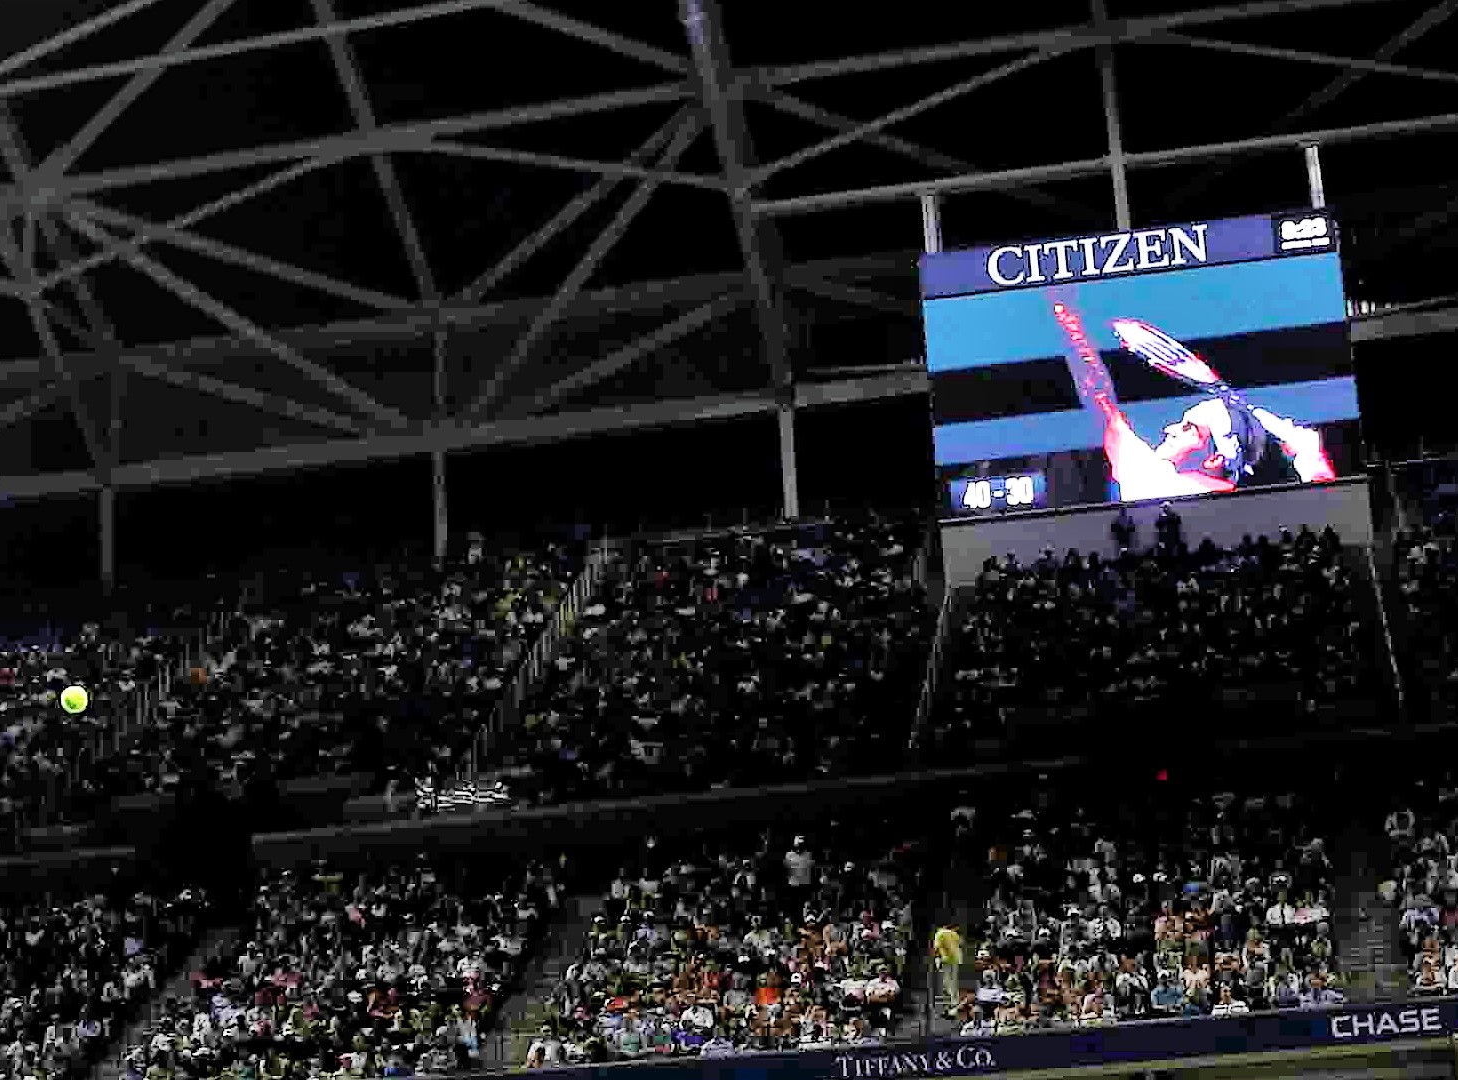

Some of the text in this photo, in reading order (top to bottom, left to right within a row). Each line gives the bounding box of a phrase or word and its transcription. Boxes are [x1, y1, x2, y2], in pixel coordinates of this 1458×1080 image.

[986, 222, 1209, 286] CITIZEN
[1331, 1008, 1443, 1039] CHASE
[936, 1050, 952, 1072] &
